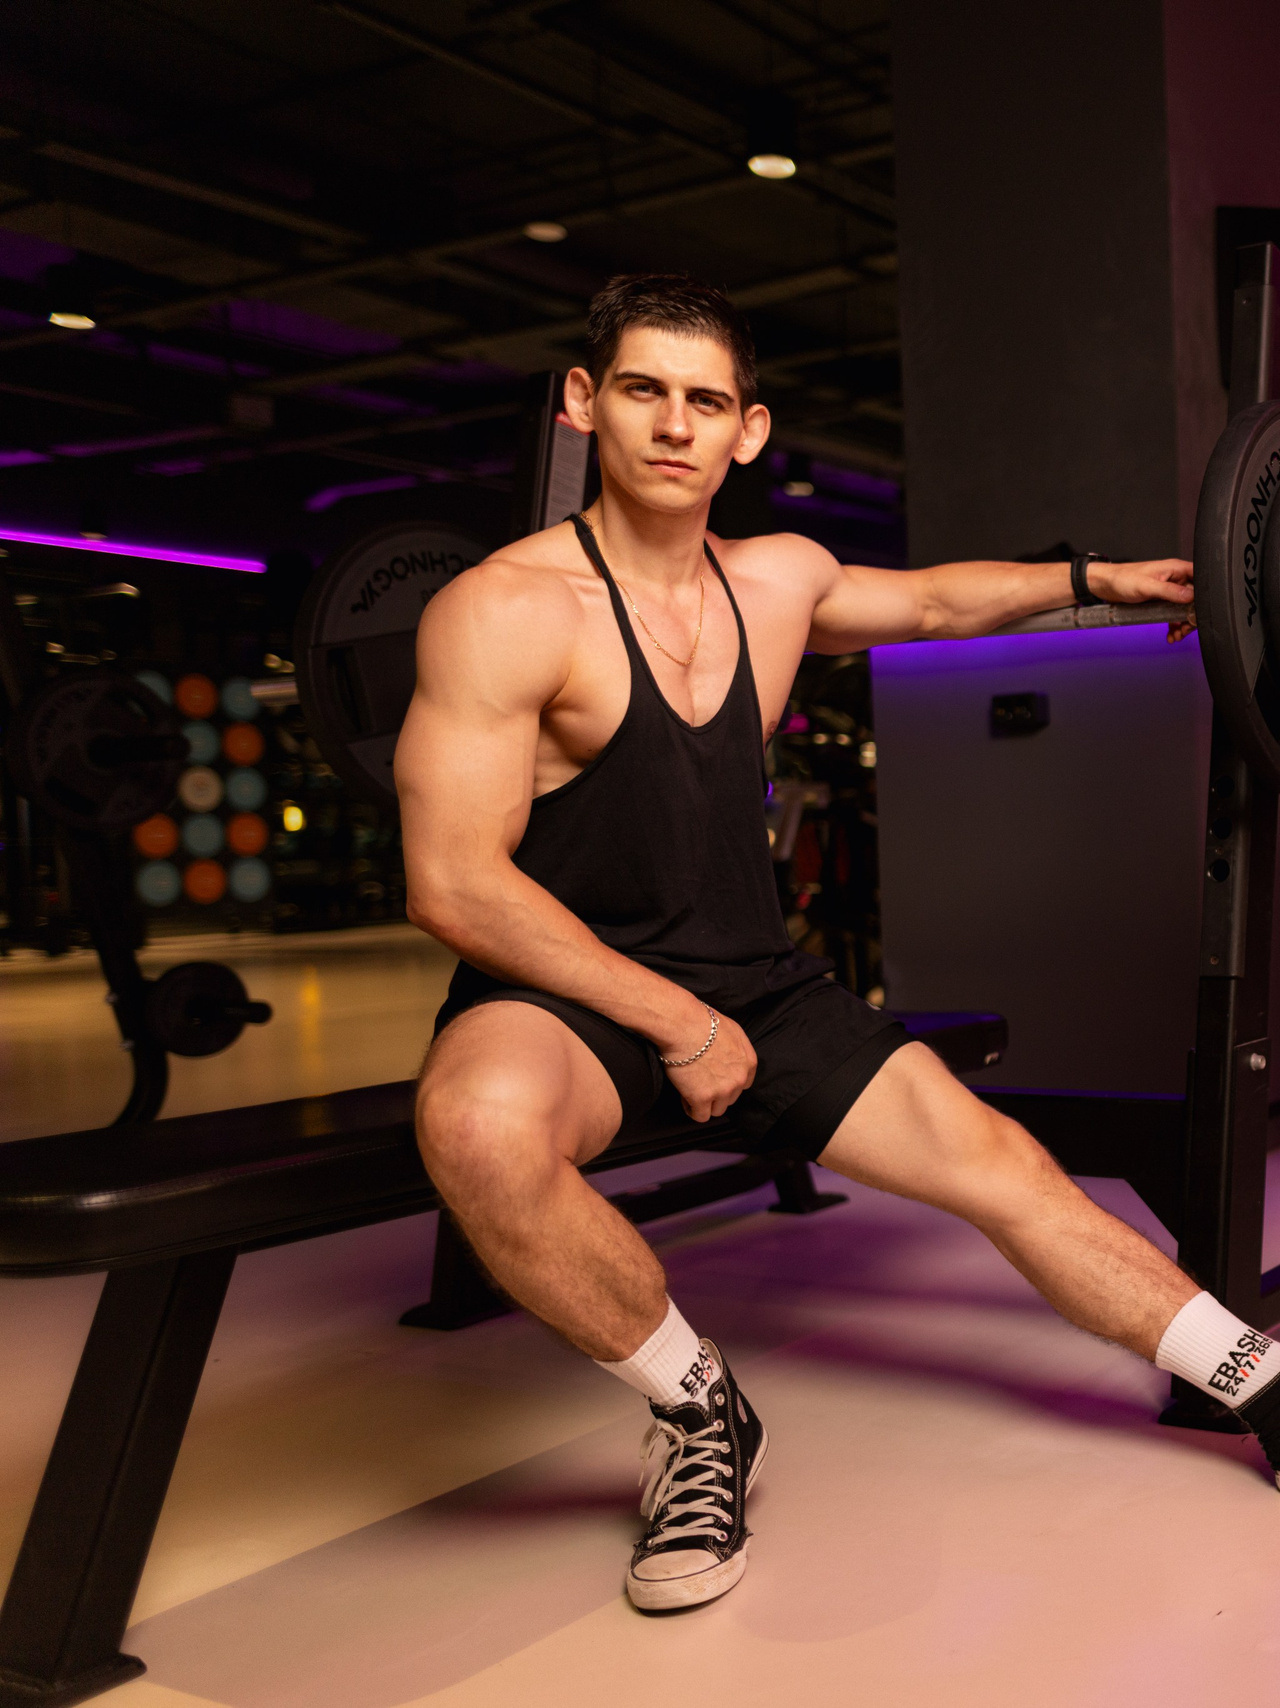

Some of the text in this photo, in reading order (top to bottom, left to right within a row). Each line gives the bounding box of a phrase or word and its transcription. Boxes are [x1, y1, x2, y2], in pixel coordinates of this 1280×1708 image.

[350, 551, 477, 613] CHNOGYM
[679, 1347, 708, 1393] EBA
[1208, 1328, 1264, 1392] EBASH
